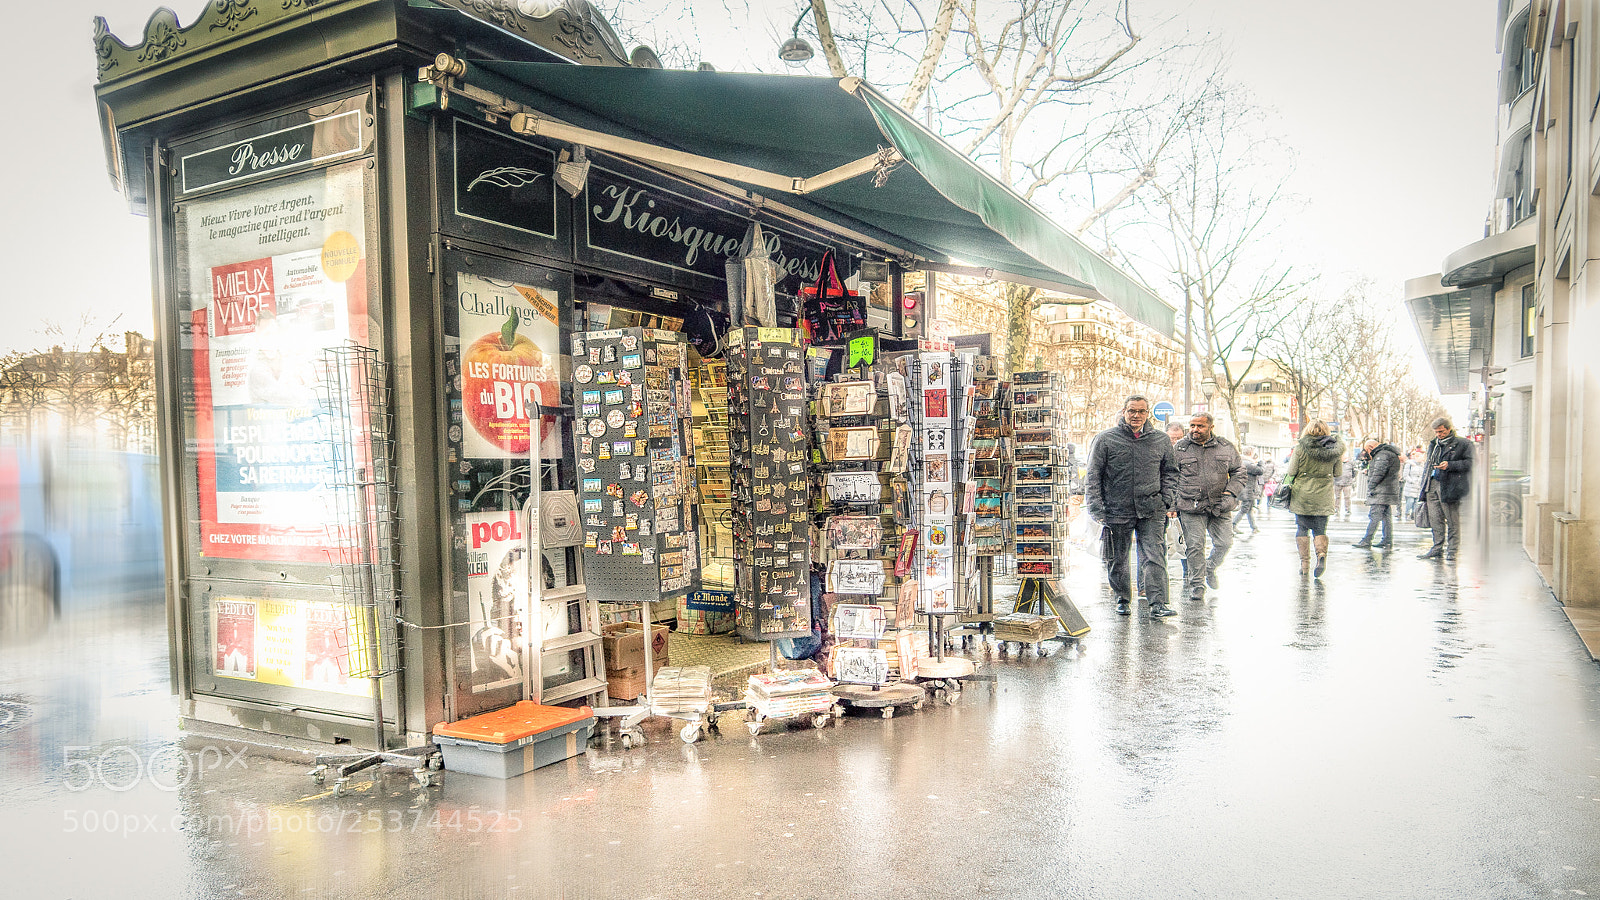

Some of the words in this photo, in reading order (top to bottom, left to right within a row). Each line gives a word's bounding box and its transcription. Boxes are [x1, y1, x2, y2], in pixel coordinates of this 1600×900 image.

[229, 142, 304, 175] Presse
[200, 213, 227, 228] Mieux
[228, 208, 252, 221] Vivre
[253, 203, 278, 216] Votre
[278, 194, 315, 213] Argent,
[209, 227, 218, 240] le
[218, 220, 261, 240] magazine
[262, 215, 278, 232] qui
[279, 211, 302, 227] rend
[303, 203, 344, 225] l'argent
[258, 226, 311, 245] intelligent.
[593, 182, 741, 266] Kiosque
[761, 230, 821, 281] Press
[324, 246, 357, 259] NOUVELLE
[325, 256, 356, 267] FORMULE
[216, 266, 270, 299] MIEUX
[216, 291, 271, 326] VIVRE
[460, 290, 543, 327] Challenge
[468, 361, 490, 379] LES
[492, 363, 548, 383] FORTUNES
[480, 388, 494, 405] du
[494, 381, 543, 420] BIO
[224, 425, 248, 444] LES
[240, 466, 259, 485] SA
[209, 534, 230, 545] CHEZ
[230, 534, 257, 545] VOTRE
[258, 534, 306, 546] MARCHAND
[693, 592, 701, 601] Le
[701, 592, 729, 602] Monde
